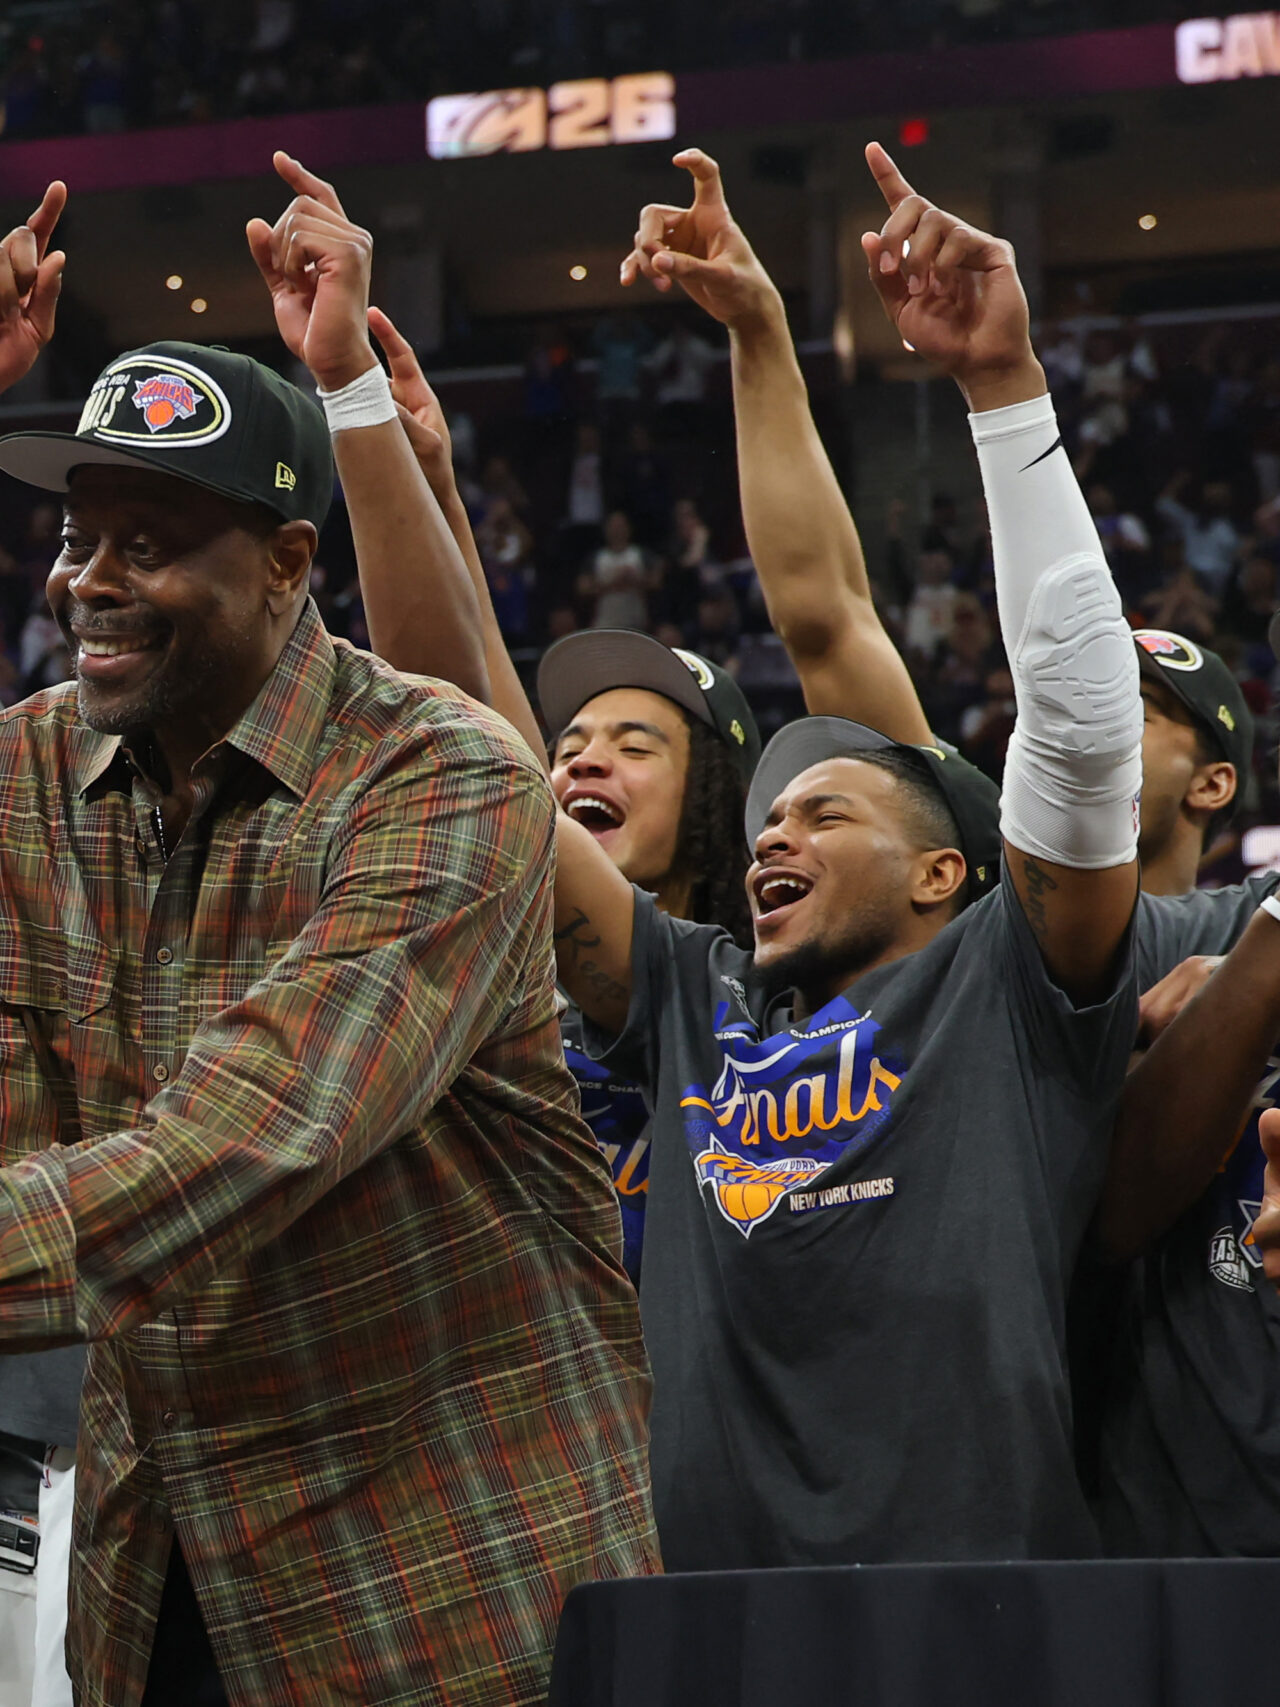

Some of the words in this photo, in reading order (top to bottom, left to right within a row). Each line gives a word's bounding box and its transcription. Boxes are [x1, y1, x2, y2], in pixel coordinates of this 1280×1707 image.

[135, 379, 194, 413] KNICKS
[789, 1192, 818, 1212] NEW
[817, 1185, 850, 1207] YORK
[850, 1177, 895, 1201] KNICKS
